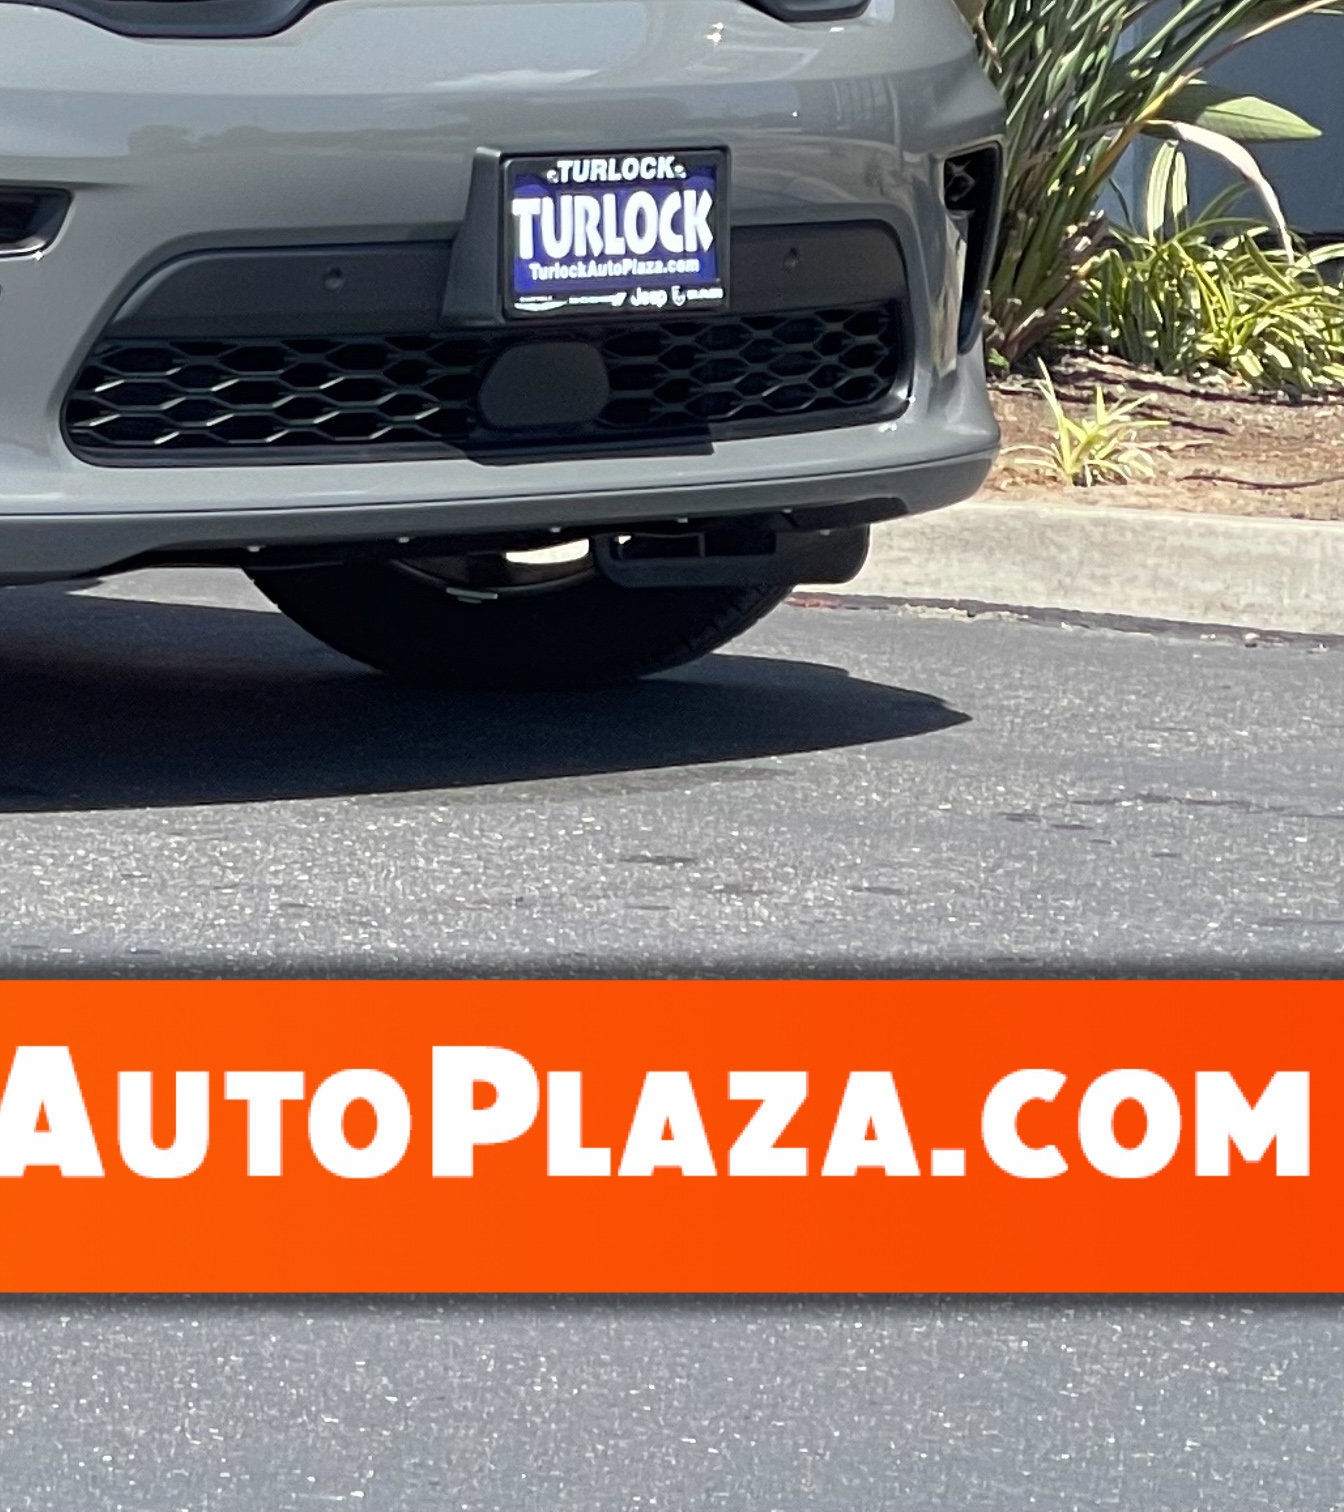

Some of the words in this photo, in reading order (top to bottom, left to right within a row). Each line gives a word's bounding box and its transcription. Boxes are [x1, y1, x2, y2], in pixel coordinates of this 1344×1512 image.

[556, 156, 676, 183] TURLOCK
[512, 189, 713, 260] TURLOCK
[528, 258, 700, 281] TurlockAutoPlaza.com
